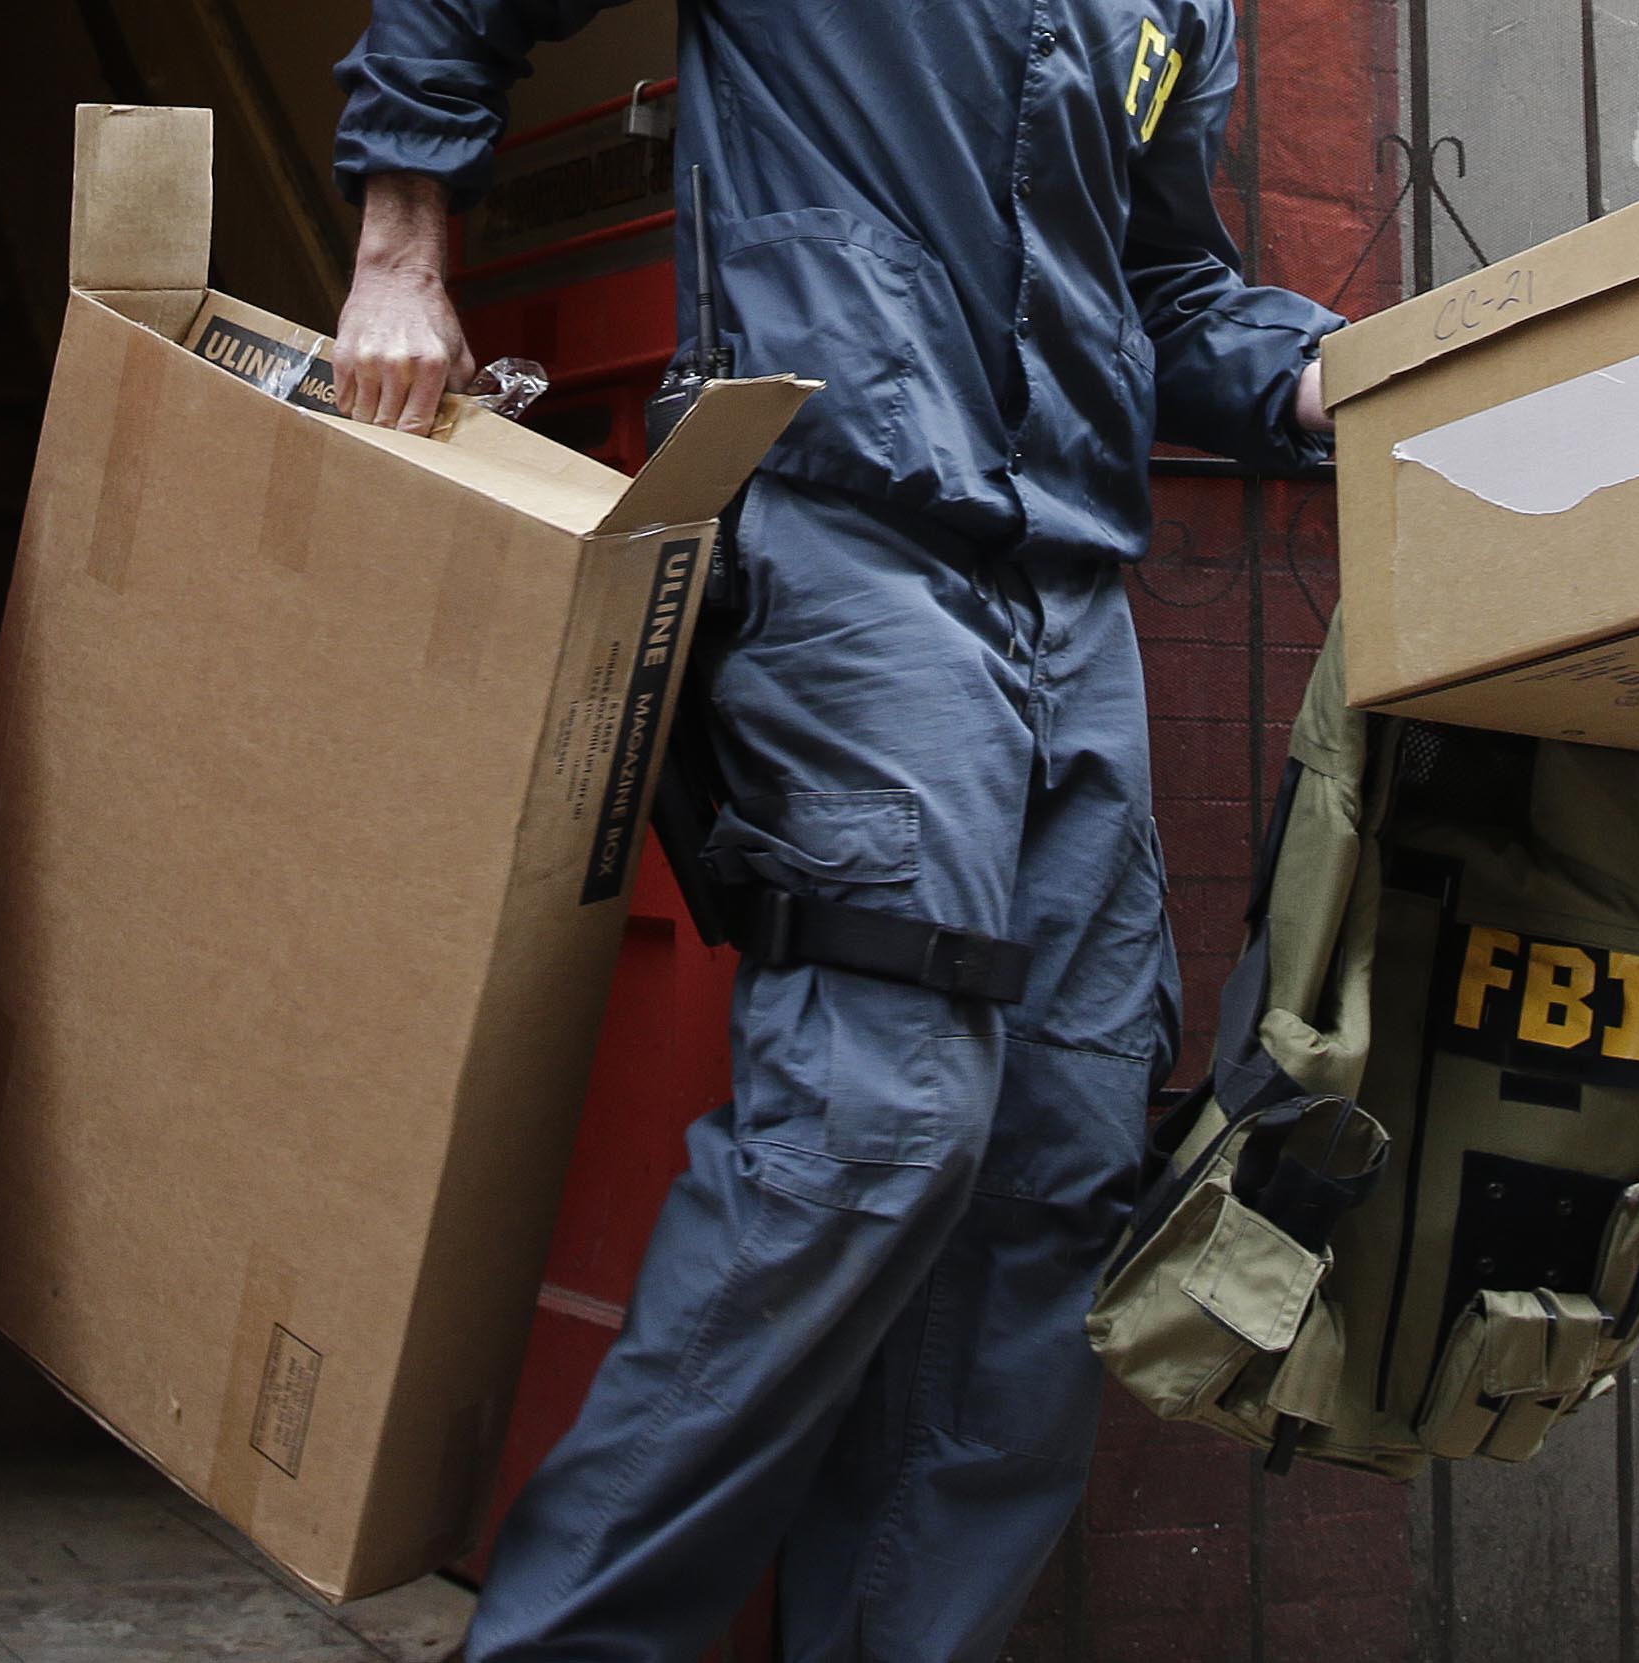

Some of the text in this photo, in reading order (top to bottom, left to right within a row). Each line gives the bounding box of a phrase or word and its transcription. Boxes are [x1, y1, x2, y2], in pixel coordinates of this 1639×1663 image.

[1124, 16, 1183, 144] FB
[598, 552, 690, 878] ULINE MAGAZINE BOX
